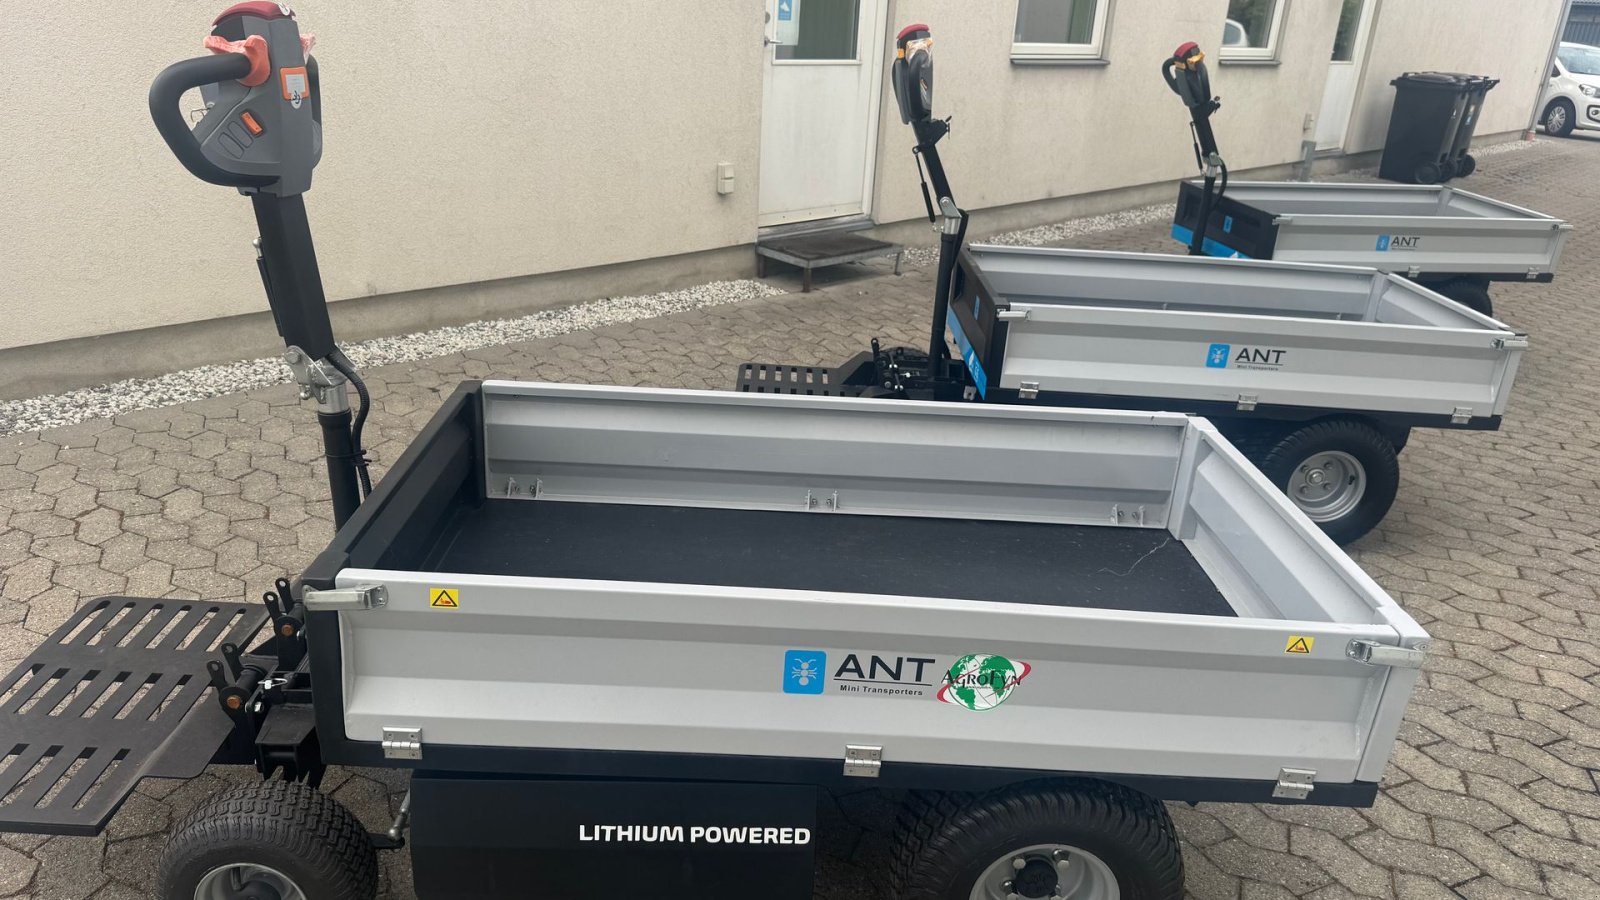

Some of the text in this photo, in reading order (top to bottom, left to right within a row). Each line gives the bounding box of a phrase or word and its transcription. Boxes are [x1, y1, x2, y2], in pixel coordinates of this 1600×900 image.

[1391, 236, 1420, 247] ANT
[1235, 347, 1287, 363] ANT
[834, 653, 936, 682] ANT
[840, 684, 923, 696] Mini Transporters
[579, 824, 811, 845] LITHIUM POWERED
